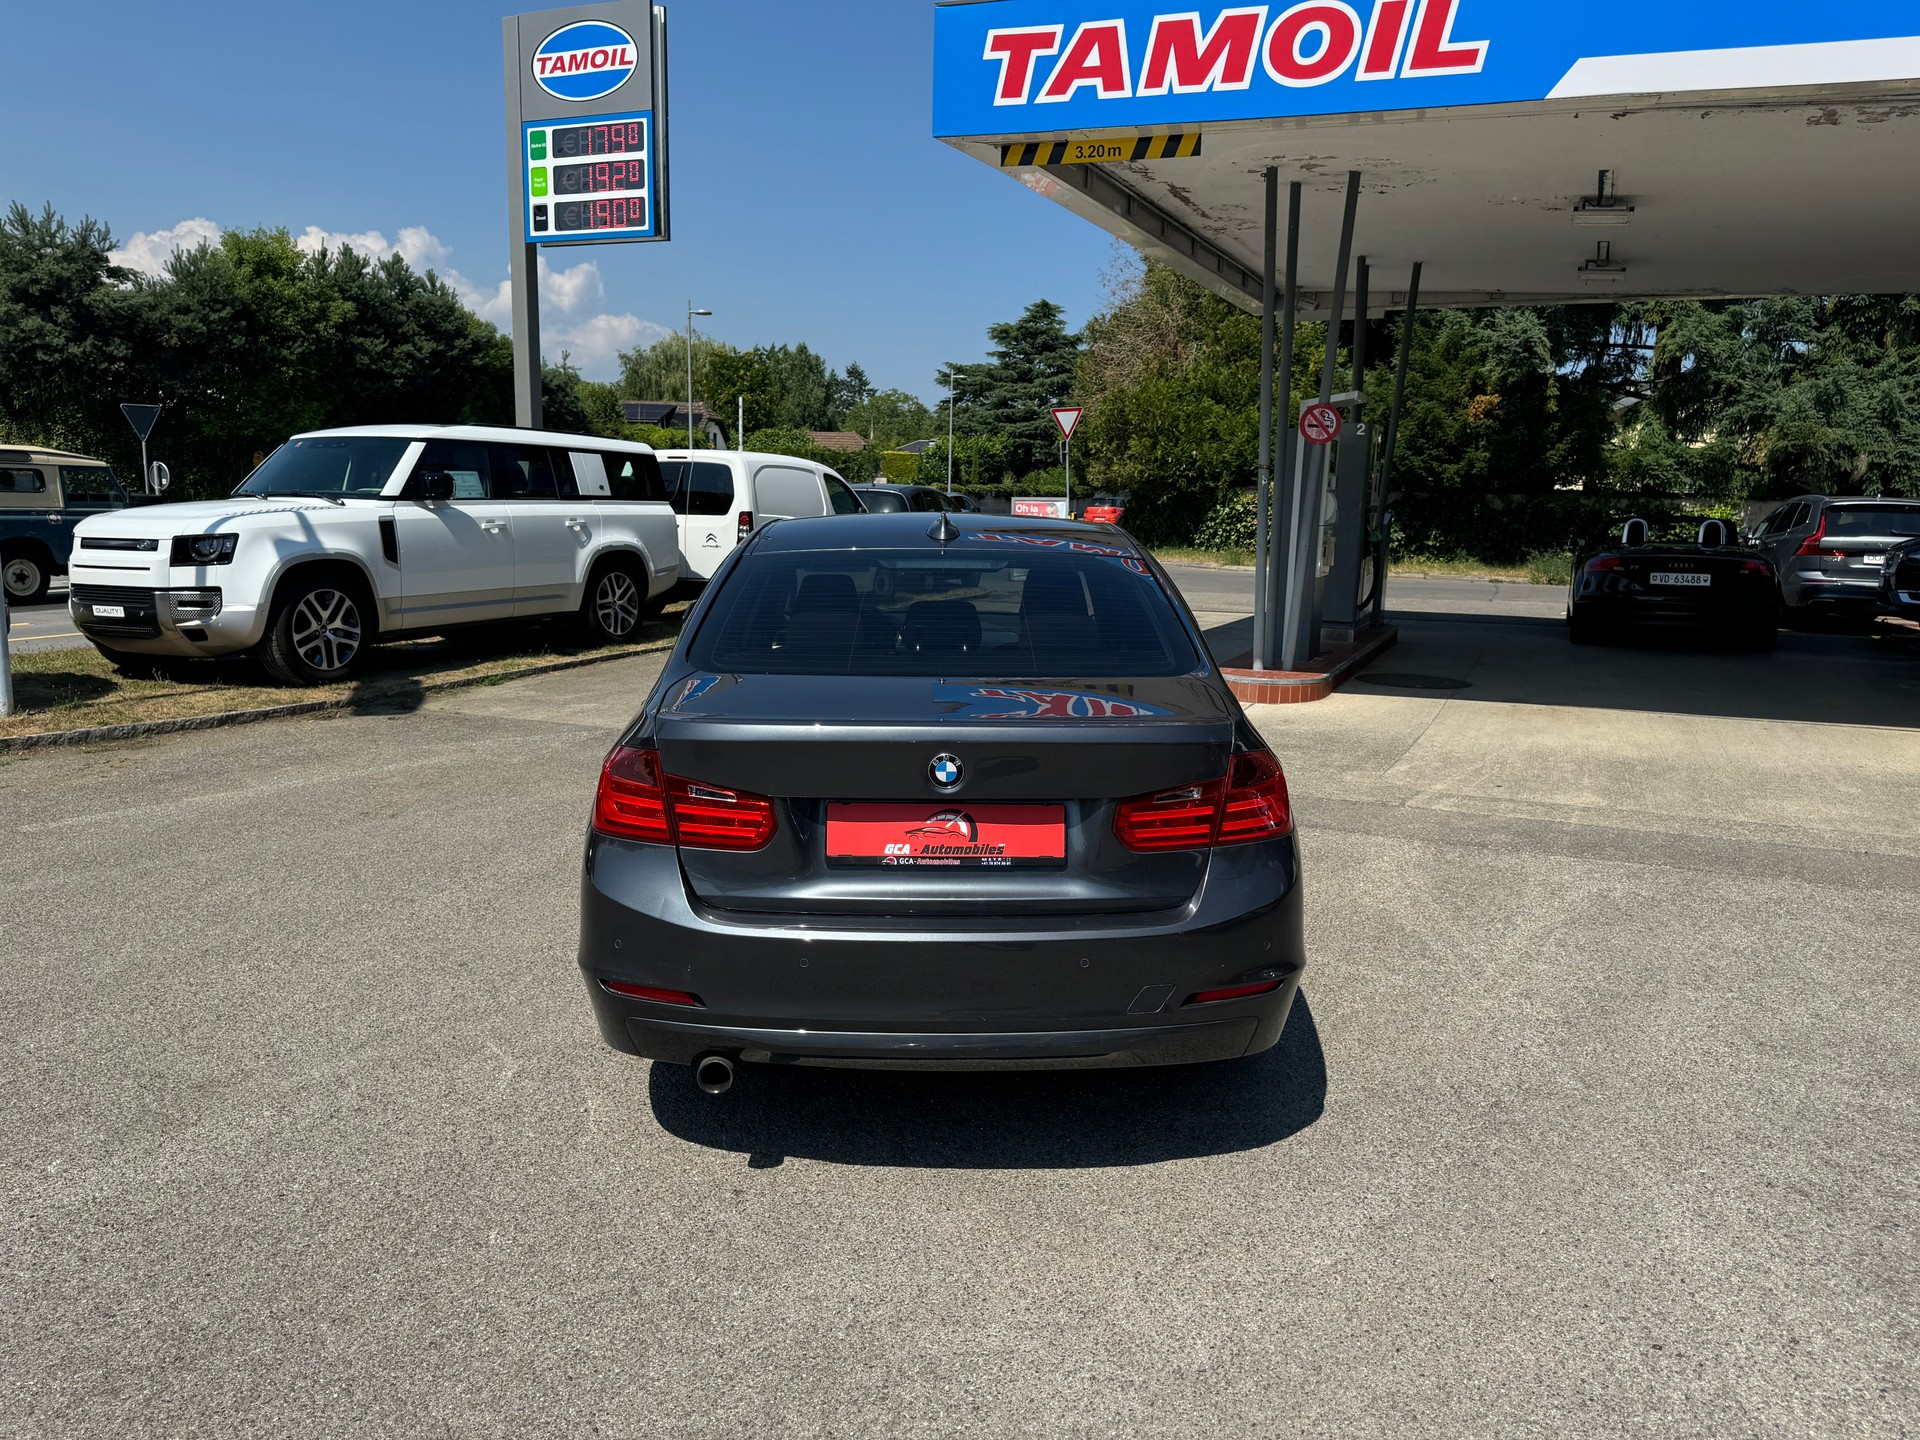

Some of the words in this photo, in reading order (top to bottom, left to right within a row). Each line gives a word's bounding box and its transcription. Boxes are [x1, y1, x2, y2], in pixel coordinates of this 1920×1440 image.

[983, 0, 1489, 106] TAMOIL
[536, 47, 634, 75] TAMOIL
[1075, 144, 1105, 159] 3.20
[1107, 145, 1122, 158] m
[1356, 423, 1365, 435] 2
[1015, 504, 1029, 513] Oh
[932, 754, 961, 767] BMW
[884, 843, 911, 855] GCA
[920, 844, 1005, 855] Automobiles
